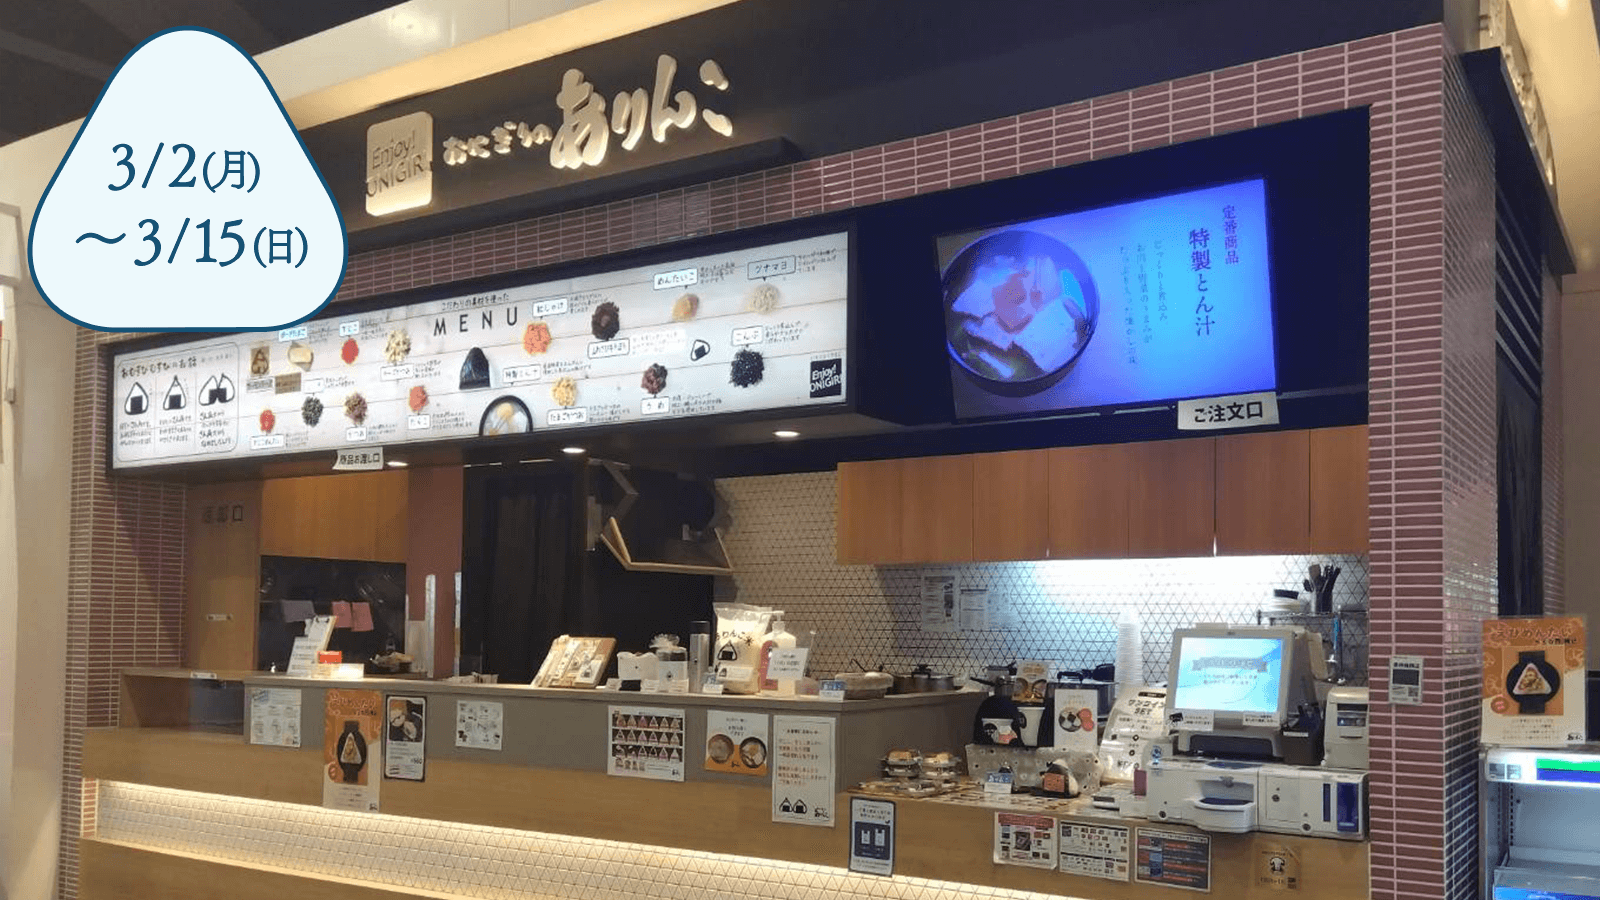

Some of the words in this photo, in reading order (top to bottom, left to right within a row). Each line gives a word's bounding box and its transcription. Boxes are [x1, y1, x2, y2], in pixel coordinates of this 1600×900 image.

[443, 120, 552, 166] おにぎりの
[550, 54, 733, 169] ありんこ
[372, 130, 416, 170] Enjoy!
[1222, 204, 1239, 265] 定番商品
[754, 260, 788, 274] ツナマヨ
[656, 271, 695, 286] めんたいこ
[1188, 227, 1216, 337] 特製とん汁
[433, 306, 518, 337] MENU
[735, 330, 759, 342] こんぶ
[811, 363, 837, 382] Enjoy!
[1194, 401, 1263, 423] ご注文口
[339, 452, 381, 465] 商品お渡し口
